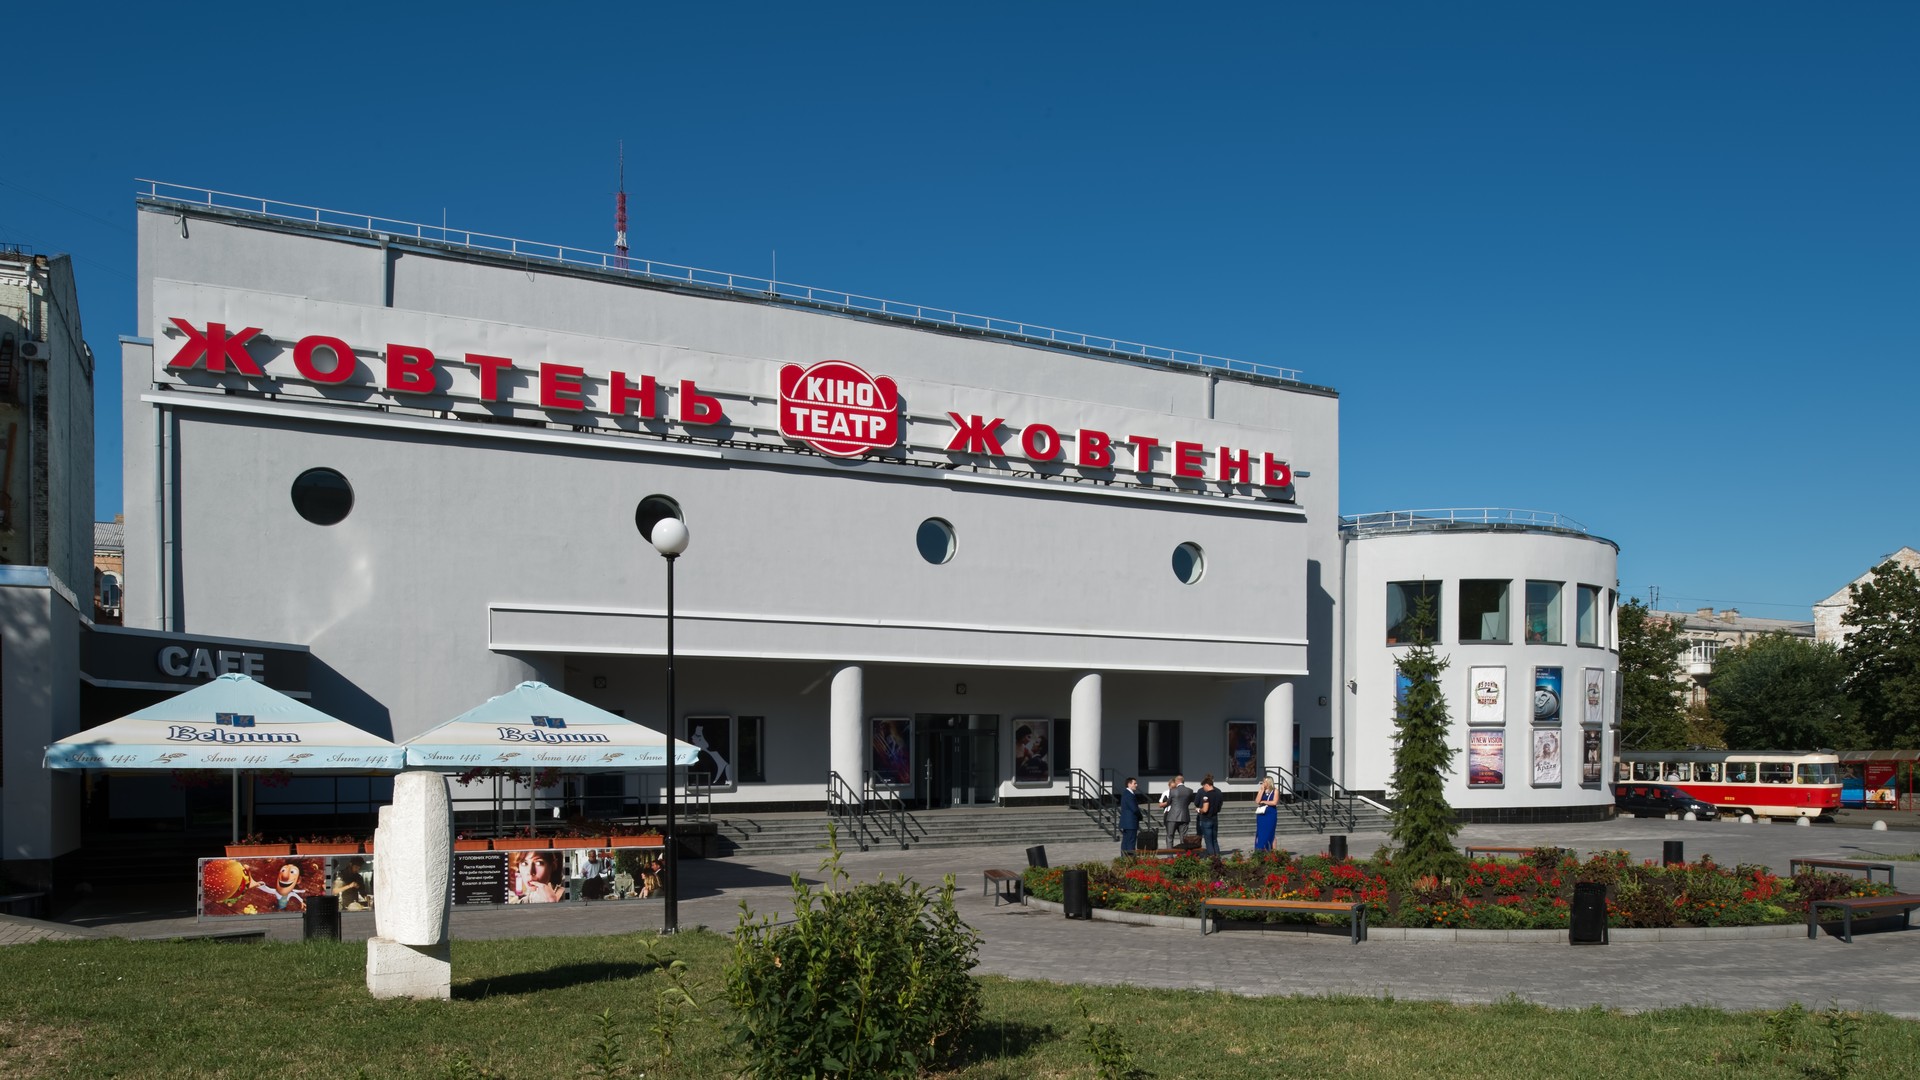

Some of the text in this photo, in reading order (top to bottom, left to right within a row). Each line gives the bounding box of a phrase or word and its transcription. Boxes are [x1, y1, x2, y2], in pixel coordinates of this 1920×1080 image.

[167, 316, 723, 425] ЖОВТЕНЬ
[807, 376, 874, 407] КІНО
[790, 406, 887, 440] ТЕАТР
[943, 411, 1292, 488] ЖОВТЕНЬ
[157, 645, 265, 682] CAFE
[65, 752, 138, 763] Anno 1445
[201, 752, 268, 763] Anno 1445
[326, 753, 390, 763] Anno 1445
[423, 752, 455, 761] Anno
[532, 752, 588, 762] Anno 1445
[634, 752, 663, 761] Anno
